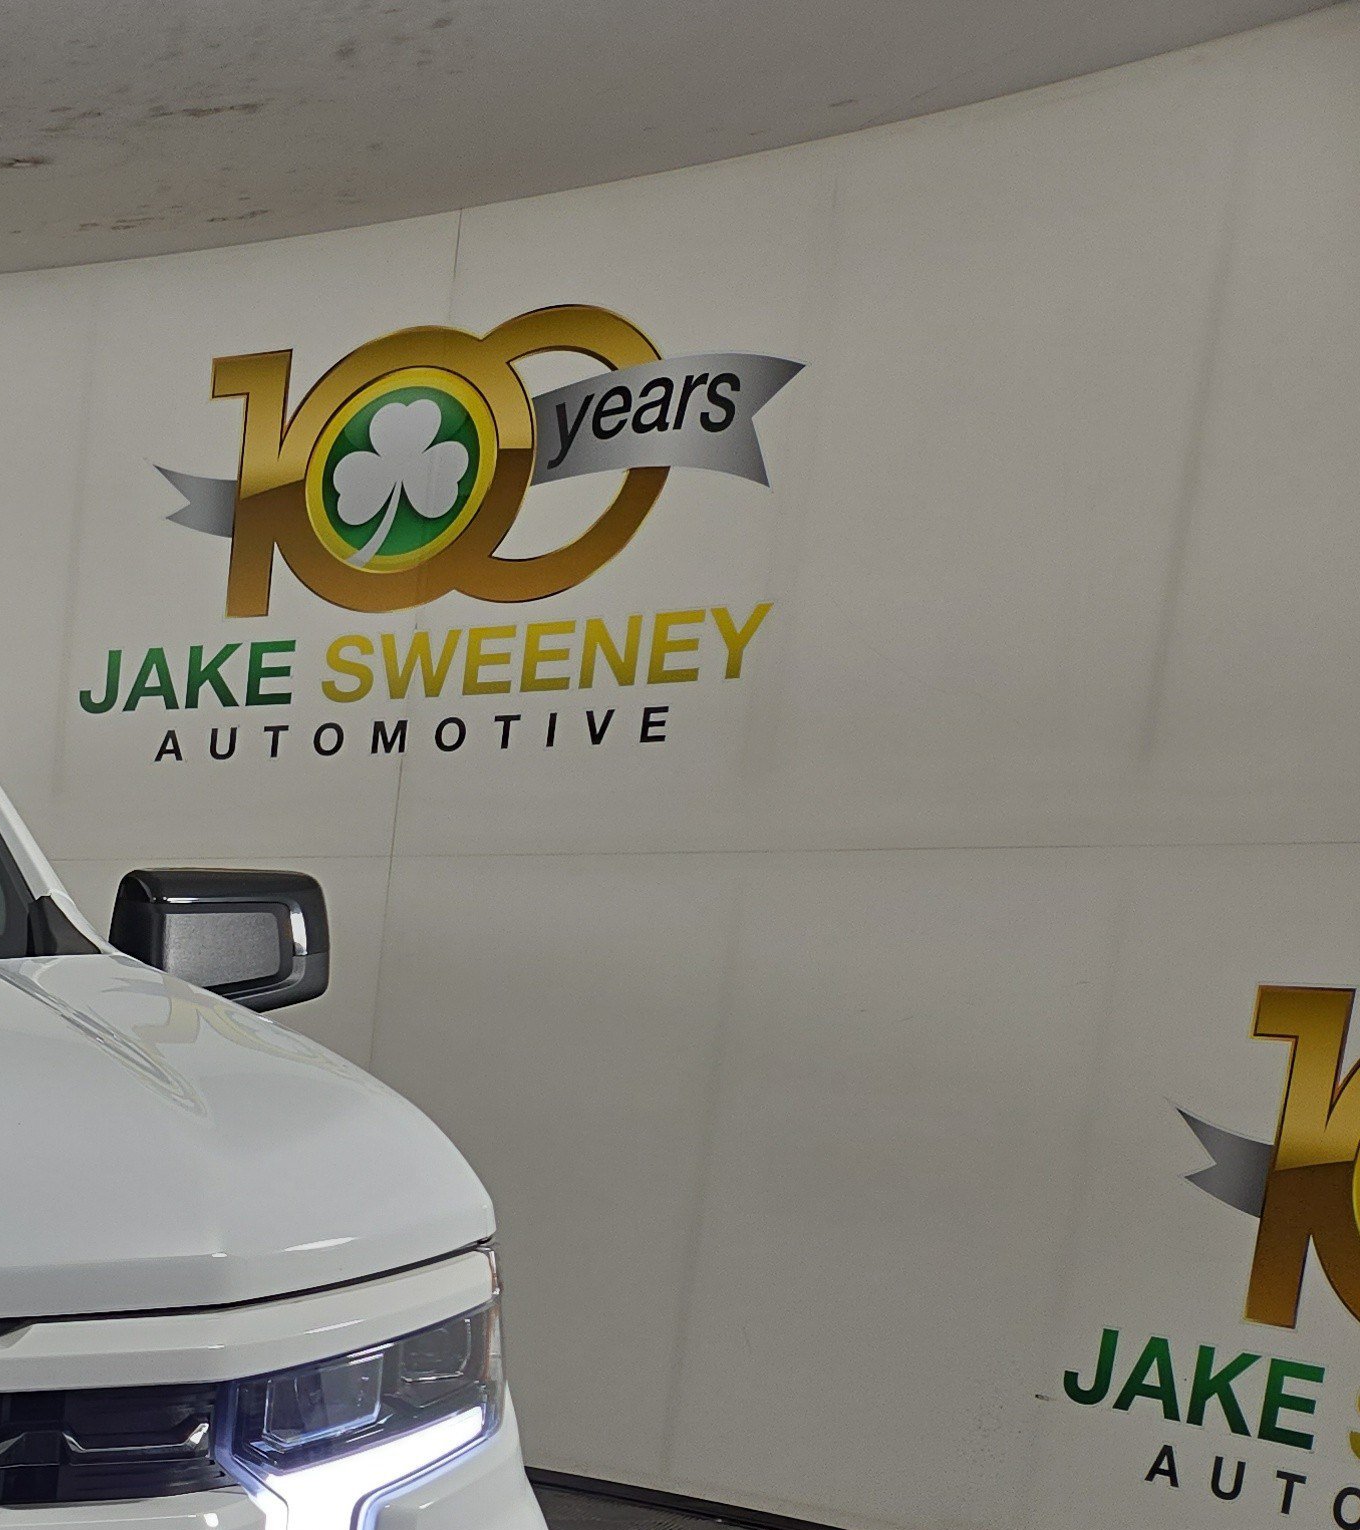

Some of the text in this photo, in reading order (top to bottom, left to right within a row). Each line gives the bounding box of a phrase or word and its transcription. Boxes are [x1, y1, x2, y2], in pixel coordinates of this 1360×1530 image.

[546, 367, 742, 470] years
[79, 602, 775, 714] JAKE SWEENEY
[153, 705, 671, 764] AUTOMOTIVE
[1063, 1326, 1326, 1450] JAKE
